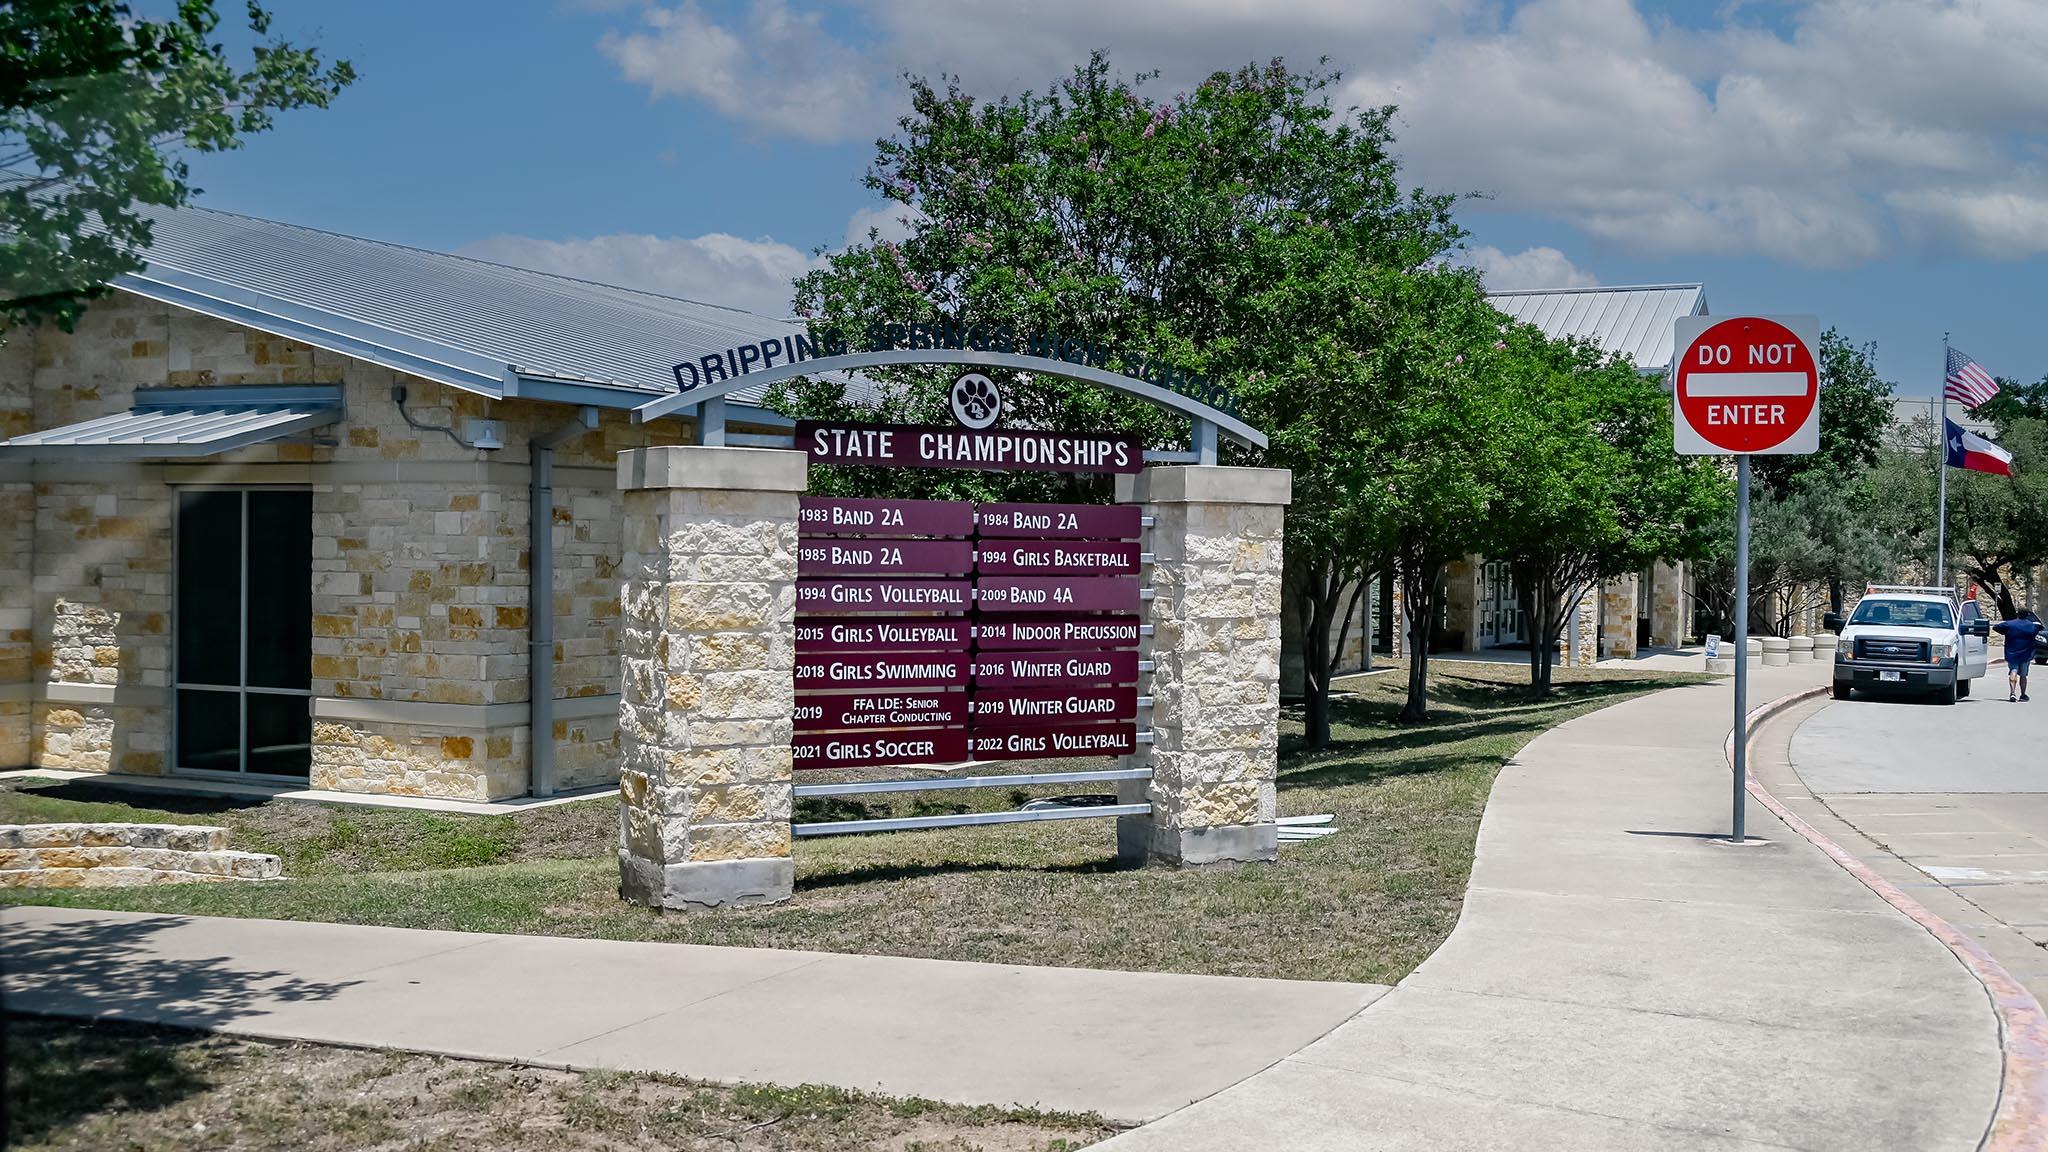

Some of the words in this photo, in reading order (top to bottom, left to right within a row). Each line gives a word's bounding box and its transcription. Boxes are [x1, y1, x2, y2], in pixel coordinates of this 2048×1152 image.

[672, 327, 847, 393] DRIPPING
[866, 320, 1014, 353] SPRINGS
[1029, 331, 1108, 369] HIGH
[1700, 345, 1730, 364] DO
[1749, 345, 1795, 364] NOT
[1708, 405, 1784, 424] ENTER
[814, 429, 893, 457] STATE
[920, 432, 1128, 466] CHAMPIONSHIPS
[800, 508, 828, 523] 1983
[833, 507, 873, 525] BAND
[882, 509, 904, 525] 2A
[984, 514, 1008, 525] 1984
[1014, 512, 1050, 529] BAND
[1058, 513, 1078, 529] 2A
[799, 548, 827, 562] 1985
[832, 547, 872, 564] BAND
[881, 548, 902, 565] 2A
[983, 552, 1006, 563] 1994
[1013, 549, 1049, 565] GIRLS
[1055, 550, 1129, 566] BASKETBALL
[799, 588, 826, 599] 1994
[831, 585, 872, 602] GIRLS
[880, 585, 963, 602] VOLLEYBALL
[981, 590, 1006, 600] 2009
[1011, 587, 1046, 603] BAND
[1053, 588, 1073, 603] 4A
[797, 628, 823, 640] 2015
[832, 625, 872, 642] GIRLS
[878, 625, 958, 642] VOLLEYBALL
[982, 626, 1005, 637] 2014
[1013, 624, 1060, 640] INDOOR
[1065, 623, 1136, 639] PERCUSSION
[797, 665, 824, 677] 2018
[830, 663, 872, 680] GIRLS
[877, 662, 955, 679] SWIMMING
[980, 664, 1004, 675] 2016
[1011, 661, 1061, 677] WINTER
[1067, 660, 1111, 676] GUARD
[794, 706, 822, 720] 2019
[854, 699, 874, 710] FFA
[878, 698, 902, 712] LDE:
[906, 698, 938, 708] SENIOR
[978, 702, 1004, 713] 2019
[1009, 699, 1062, 715] WINTER
[1066, 697, 1115, 713] GUARD
[842, 713, 885, 724] CHAPTER
[890, 711, 951, 722] CONDUCTING
[793, 746, 820, 759] 2021
[827, 742, 871, 759] GIRLS
[876, 740, 933, 757] SOCCER
[977, 738, 1002, 750] 2022
[1008, 735, 1045, 751] GIRLS
[1053, 734, 1128, 749] VOLLEYBALL
